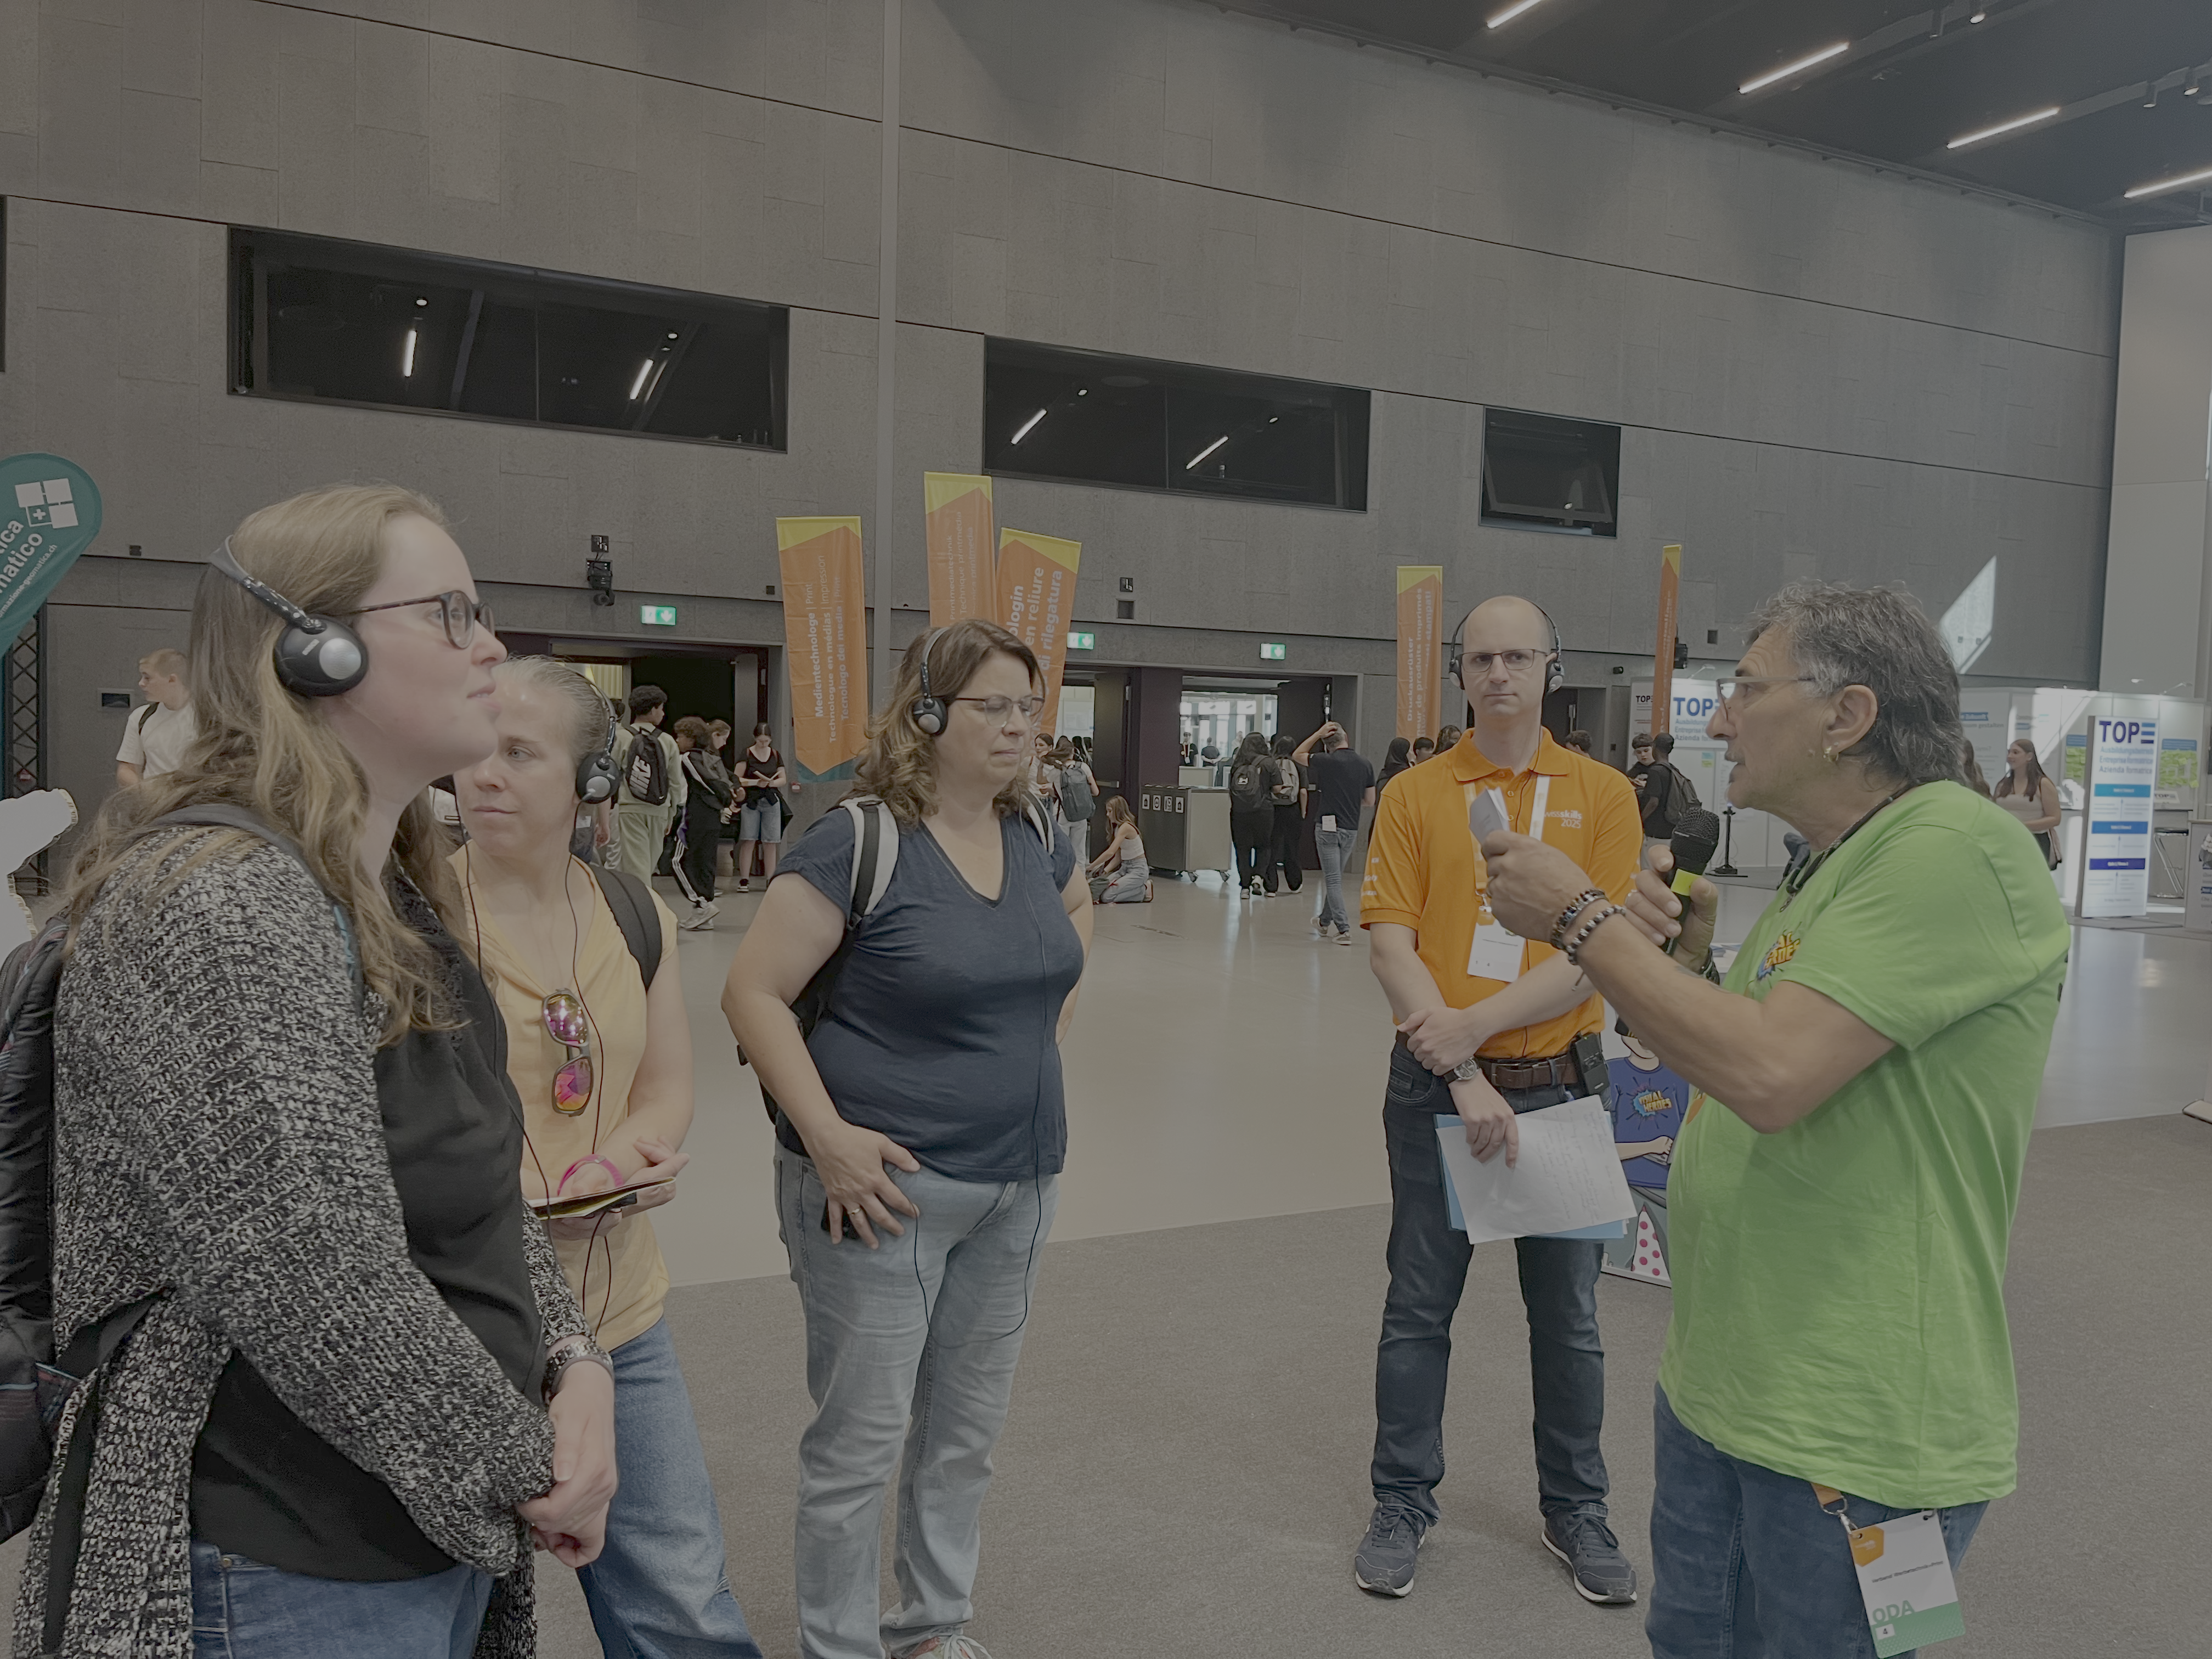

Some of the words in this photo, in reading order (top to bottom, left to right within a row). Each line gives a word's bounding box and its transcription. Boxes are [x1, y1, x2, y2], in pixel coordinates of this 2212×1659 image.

[805, 583, 814, 604] Print
[817, 555, 830, 604] Impression
[946, 535, 955, 620] Printmediatechnik
[959, 567, 967, 614] Technique
[1027, 567, 1043, 621] reliure
[836, 605, 844, 641] media
[1041, 570, 1063, 650] rilegatura
[822, 612, 833, 653] médias
[836, 644, 845, 661] dei
[1025, 627, 1036, 646] en
[807, 612, 823, 718] Medientechnologe
[827, 656, 833, 670] en
[1415, 644, 1424, 691] produits
[828, 673, 837, 743] Technologue
[838, 664, 849, 720] Tecnologo
[1415, 695, 1422, 708] de
[1561, 818, 1581, 828] 2025
[1638, 1091, 1663, 1104] VISUAL
[1643, 1098, 1672, 1112] HEROES
